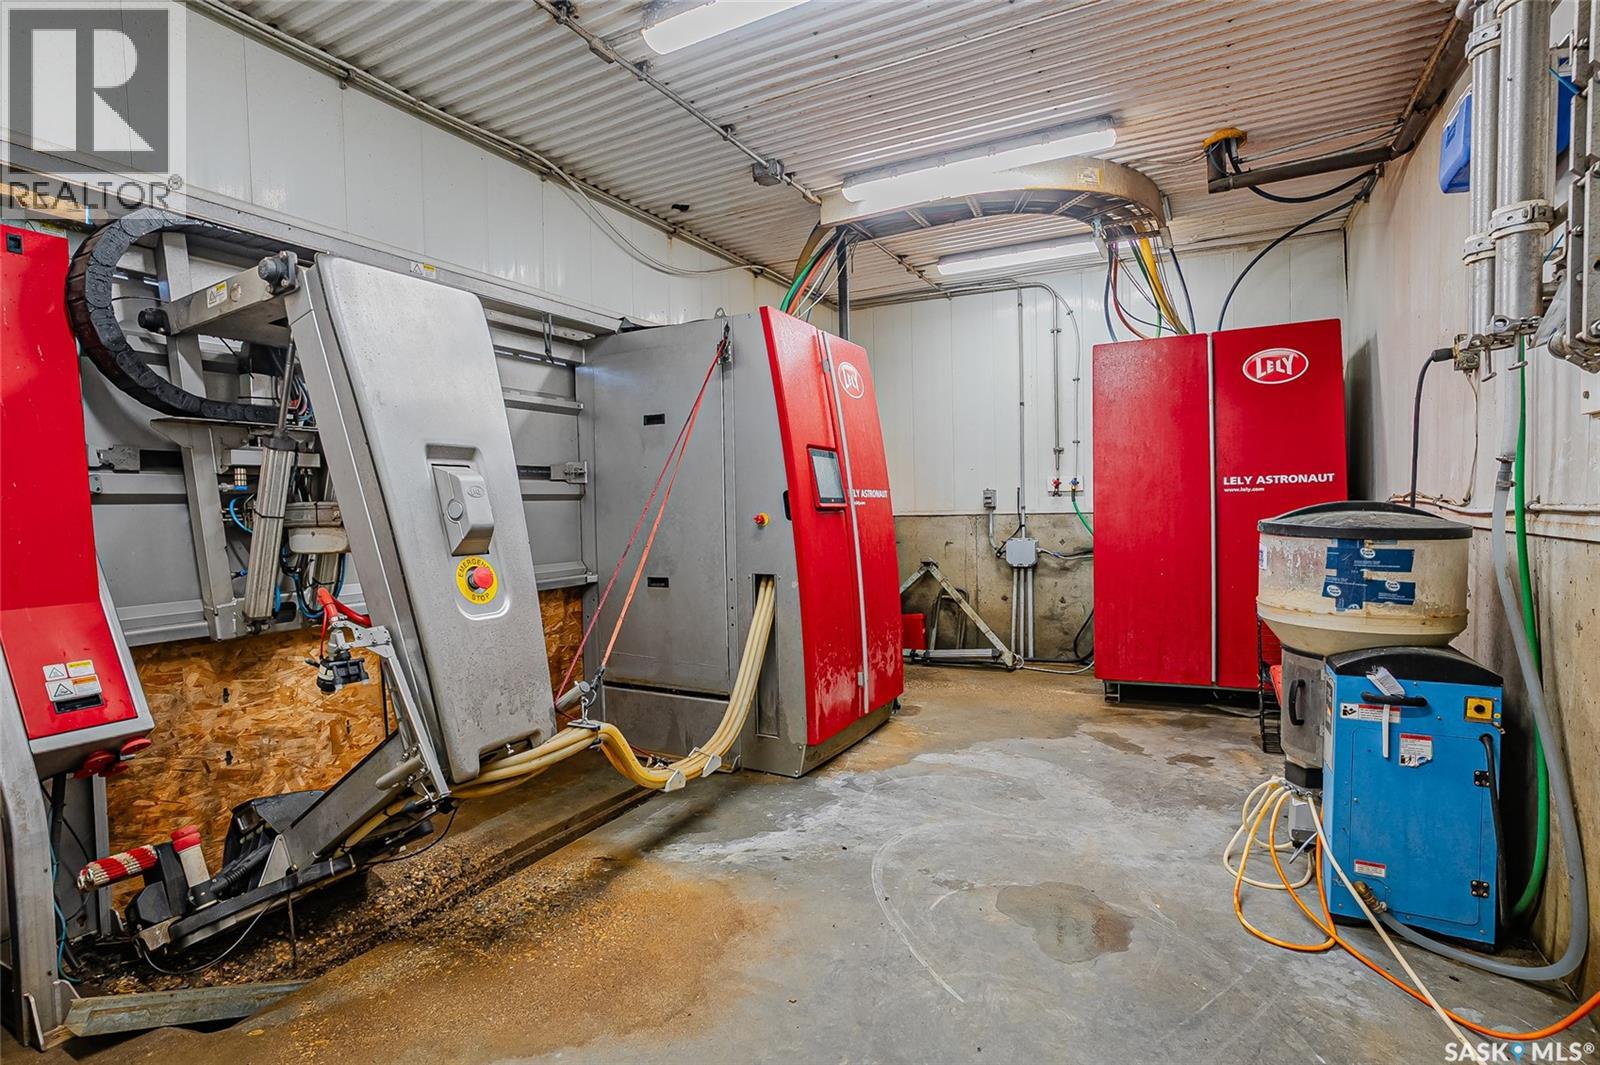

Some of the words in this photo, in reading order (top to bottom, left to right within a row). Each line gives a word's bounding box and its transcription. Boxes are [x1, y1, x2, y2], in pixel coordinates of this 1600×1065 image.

[1254, 352, 1297, 379] LELY
[1223, 475, 1253, 486] LELY
[1256, 472, 1335, 485] ASTRONAUT
[471, 592, 490, 602] STOP
